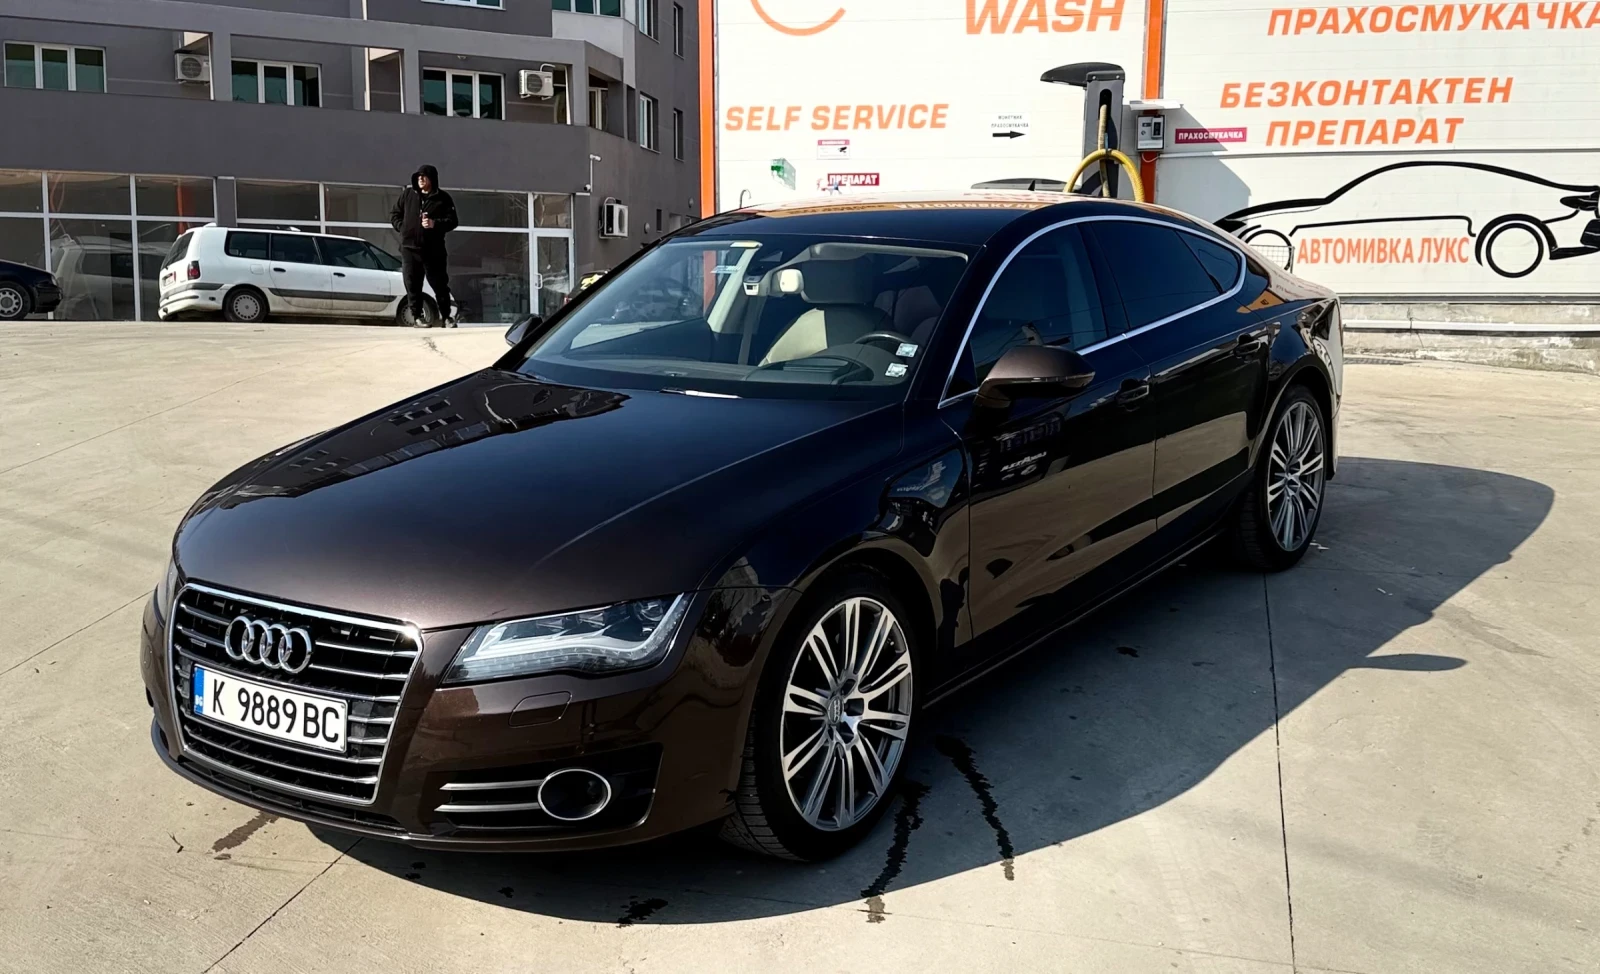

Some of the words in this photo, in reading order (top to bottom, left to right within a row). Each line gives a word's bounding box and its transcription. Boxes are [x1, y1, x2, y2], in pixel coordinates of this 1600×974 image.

[966, 0, 1125, 34] WASH
[1268, 1, 1600, 36] ПРАХОСМУКАЧКА
[1220, 77, 1513, 108] БЕЗКОНТАКТЕН
[725, 106, 801, 131] SELF
[811, 104, 949, 131] SERVICE
[1178, 131, 1243, 140] ПРАХОСМУКАЧКА
[1266, 118, 1464, 146] ПРЕПАРАТ
[829, 174, 878, 185] ПРЕПАРАТ
[1297, 238, 1414, 264] АВТОМИВКА
[1417, 237, 1470, 264] ЛУКС
[213, 679, 225, 716] K
